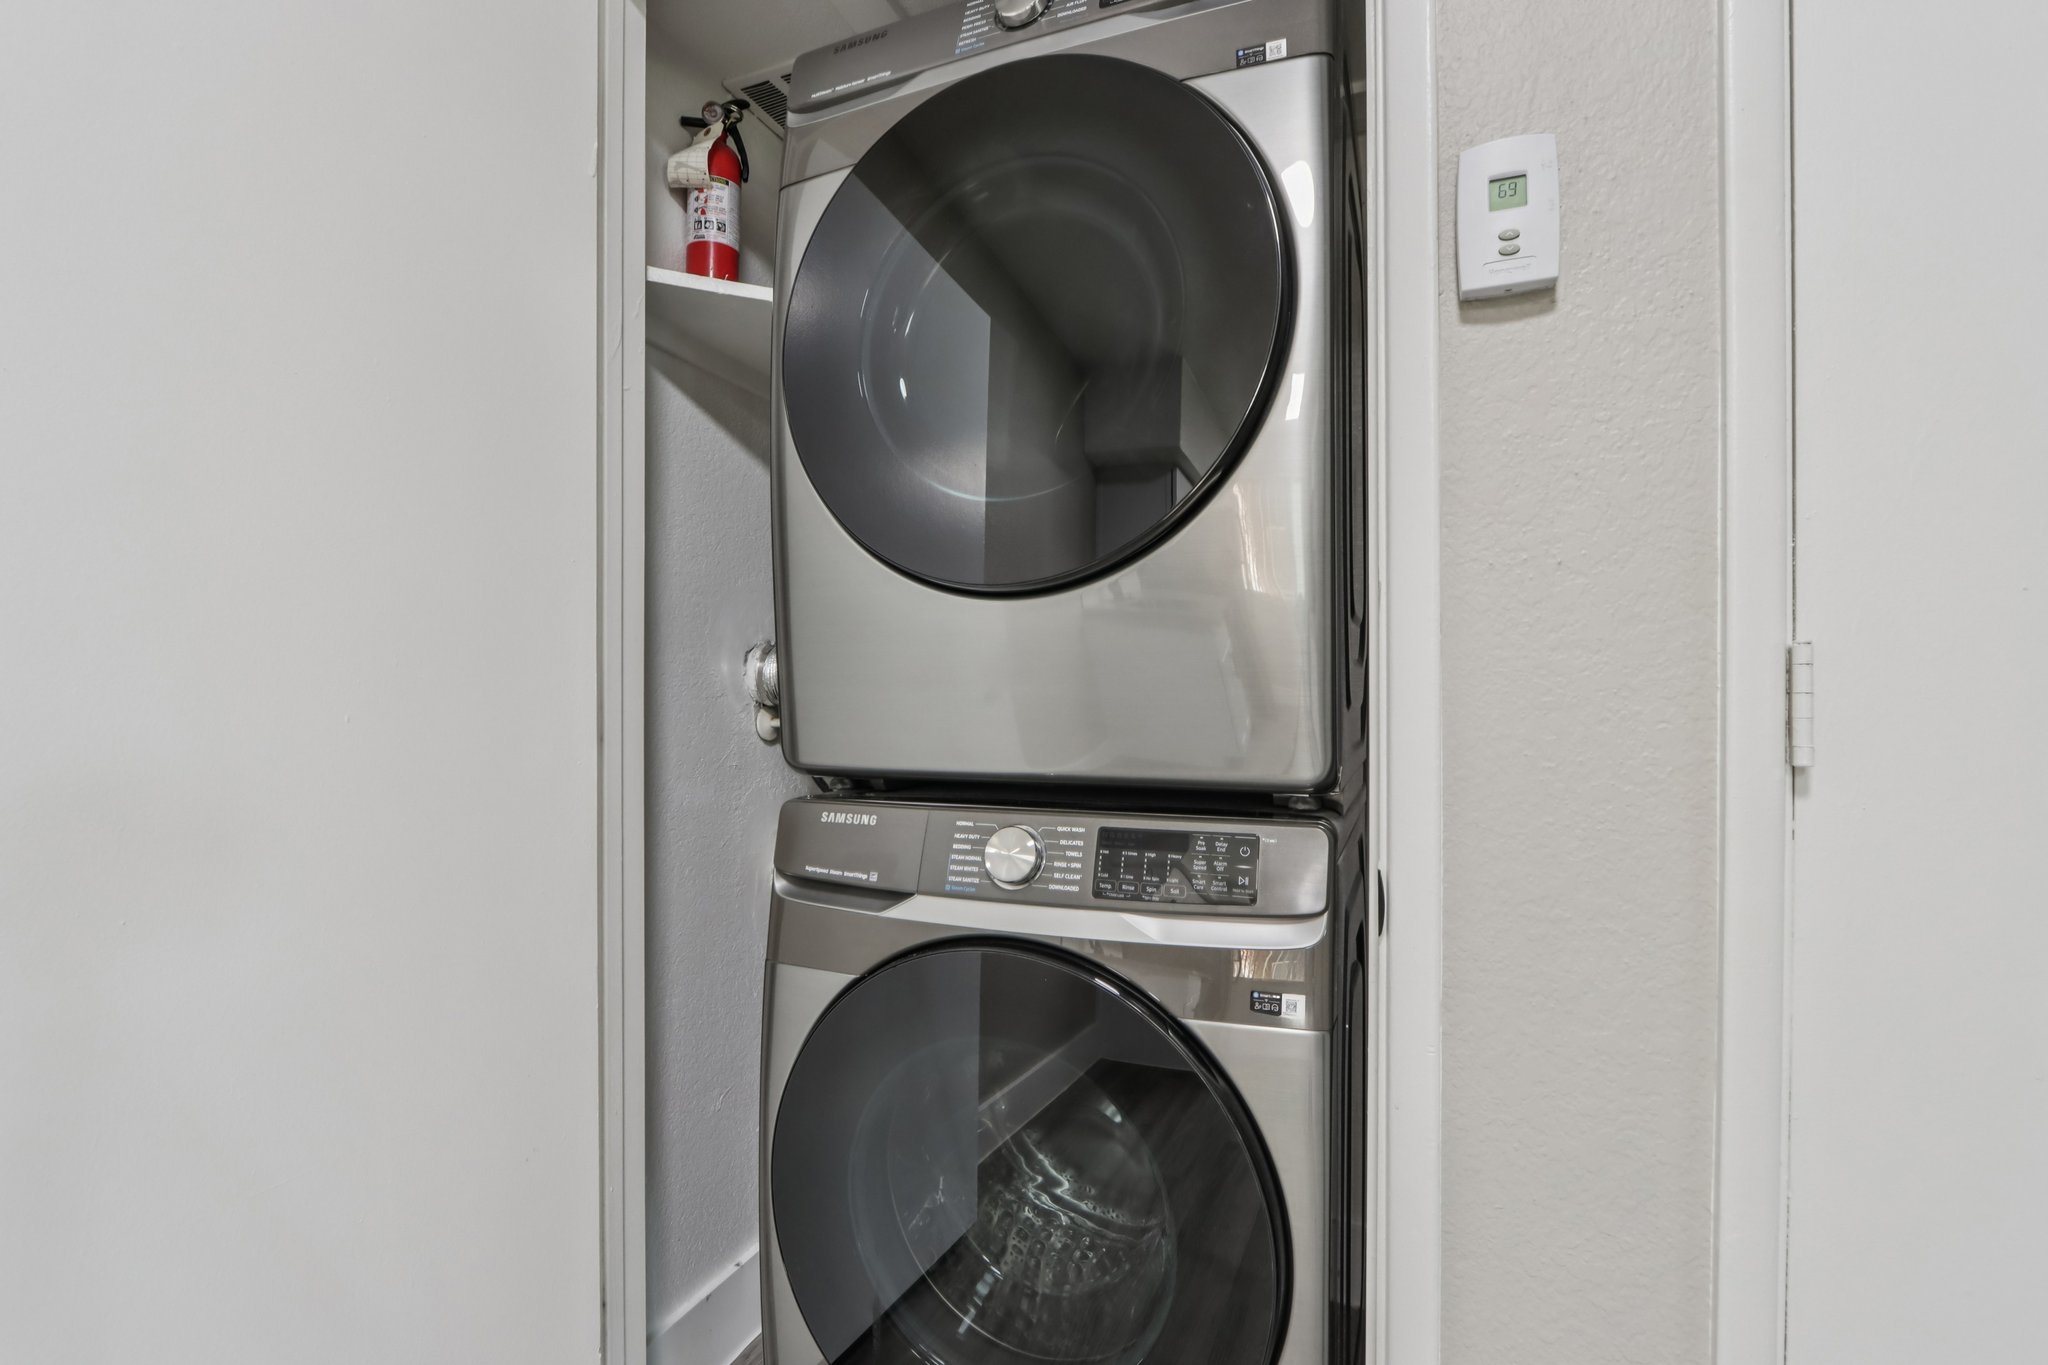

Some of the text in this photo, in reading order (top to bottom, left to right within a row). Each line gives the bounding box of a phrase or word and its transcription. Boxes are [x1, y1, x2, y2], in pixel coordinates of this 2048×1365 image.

[833, 30, 888, 55] SAMSUNG
[1498, 181, 1517, 199] 69
[821, 812, 877, 825] SAMSUNG
[1048, 884, 1080, 892] DOWNLOADED
